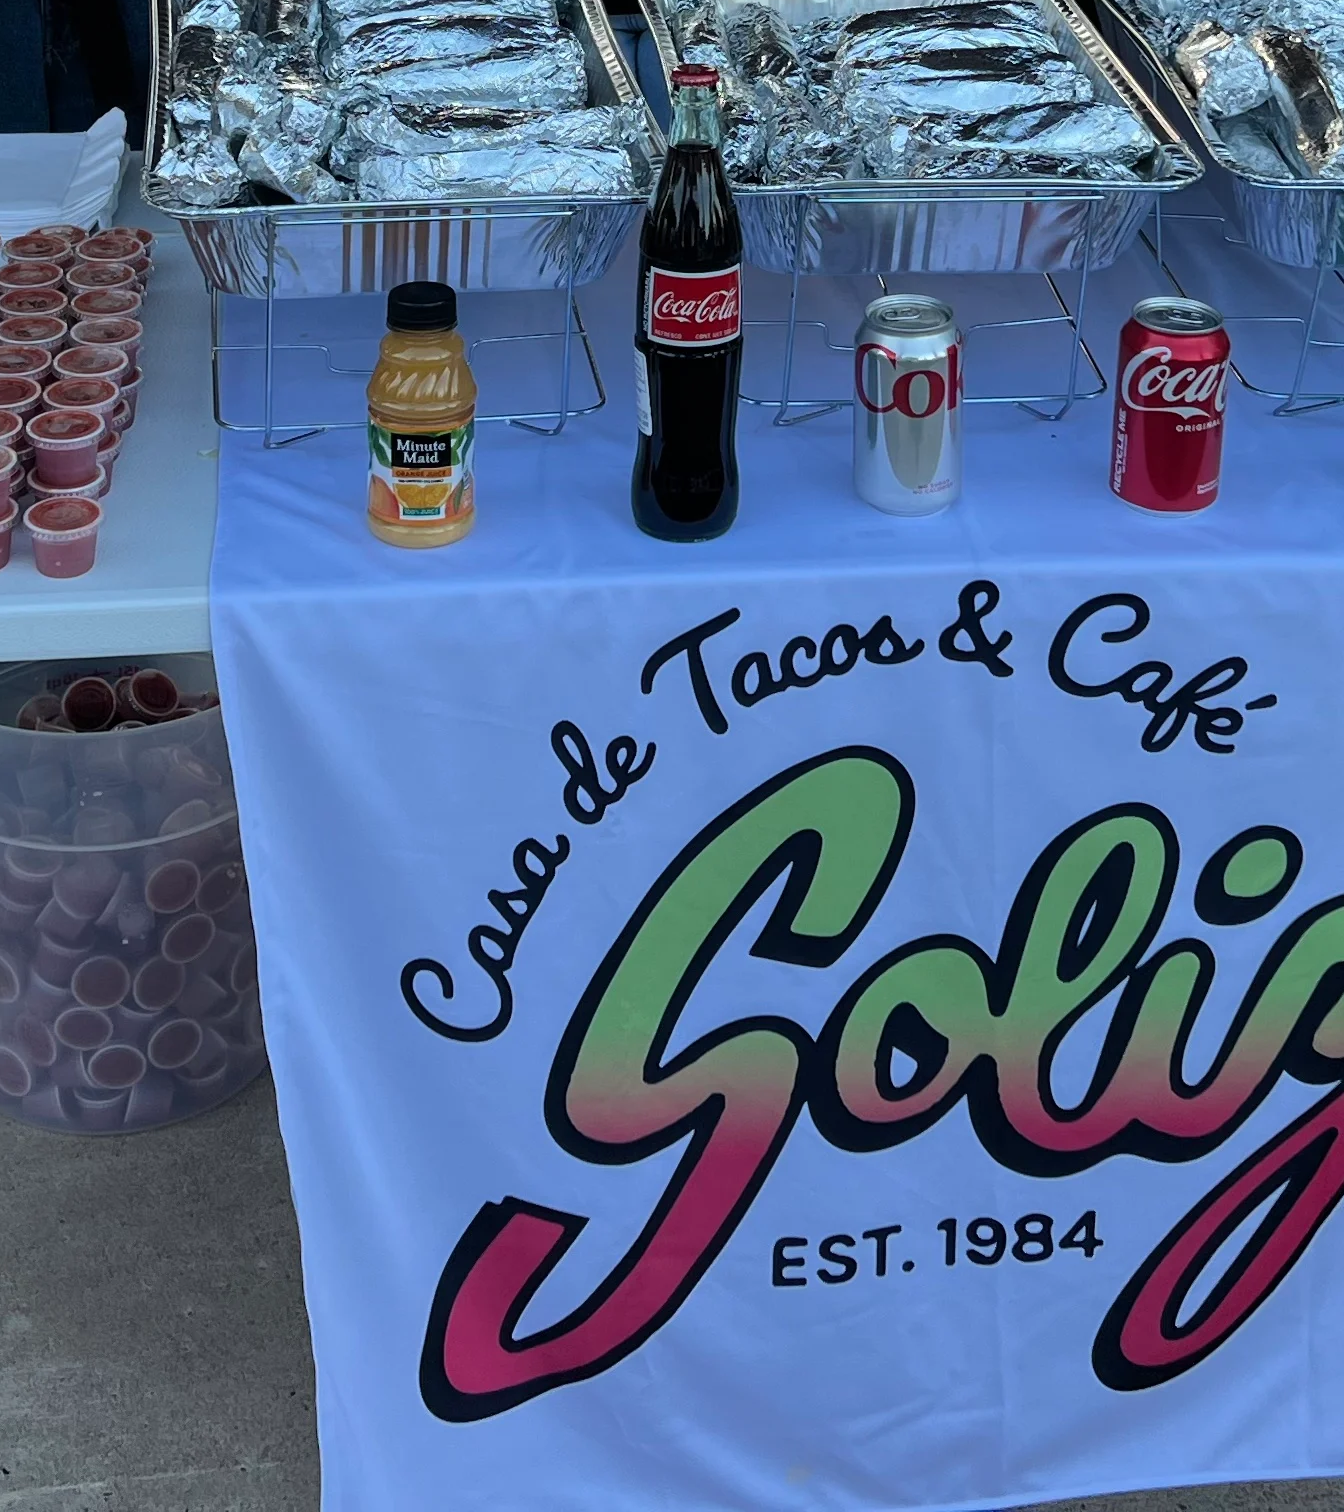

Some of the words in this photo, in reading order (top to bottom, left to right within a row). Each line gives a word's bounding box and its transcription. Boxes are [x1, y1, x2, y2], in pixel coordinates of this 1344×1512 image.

[653, 286, 739, 324] Coca-Cola
[1119, 407, 1127, 433] ME
[1175, 418, 1221, 433] ORIGINAL
[396, 438, 446, 451] Minute
[403, 451, 440, 464] Maid
[426, 469, 446, 477] JUICE
[1113, 433, 1126, 494] RECYCLE
[400, 835, 569, 1043] Casa
[550, 719, 657, 826] de
[641, 606, 927, 735] Tacos
[937, 578, 1014, 679] &
[1047, 591, 1280, 755] Café
[770, 1231, 915, 1289] EST.
[934, 1208, 1105, 1268] 1984
